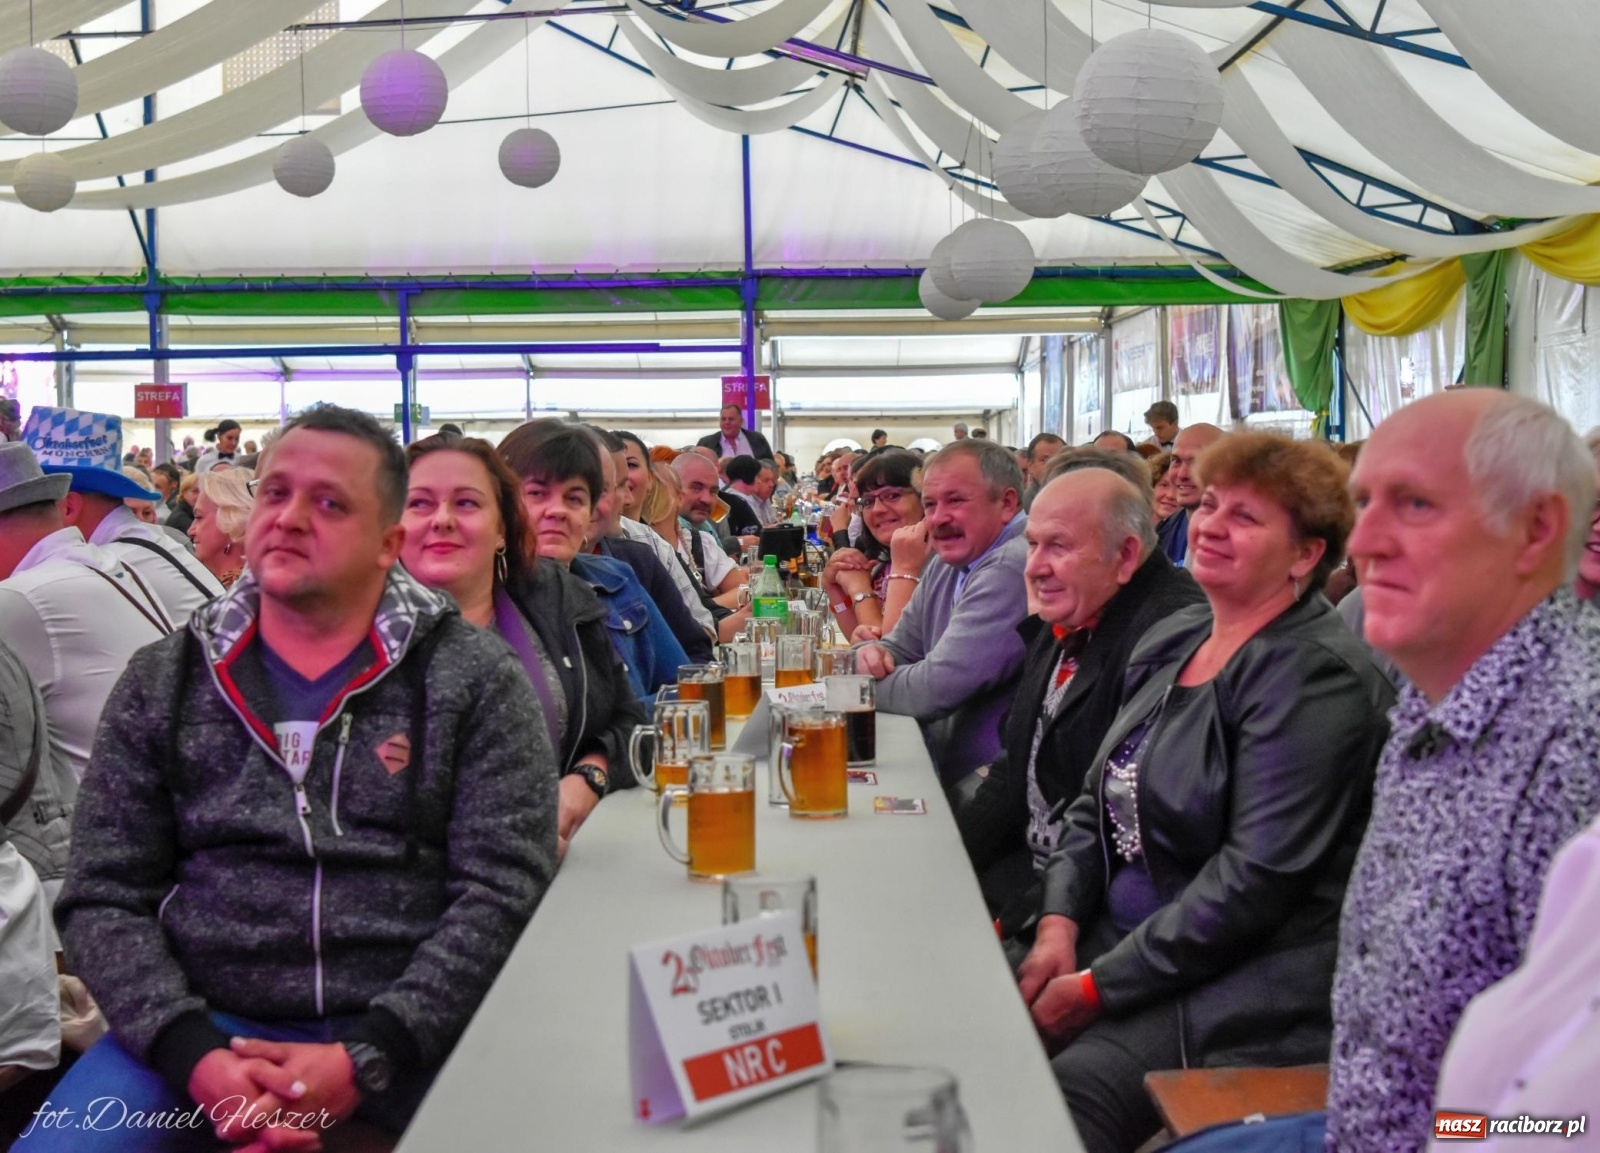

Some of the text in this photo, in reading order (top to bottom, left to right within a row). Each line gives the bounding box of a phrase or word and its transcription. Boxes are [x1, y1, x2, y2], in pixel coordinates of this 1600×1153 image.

[724, 382, 768, 392] STRFA
[137, 391, 180, 401] STREFA
[42, 446, 109, 458] MÜNCHEN
[697, 985, 771, 1026] SEKTOR
[722, 1037, 788, 1090] NR C
